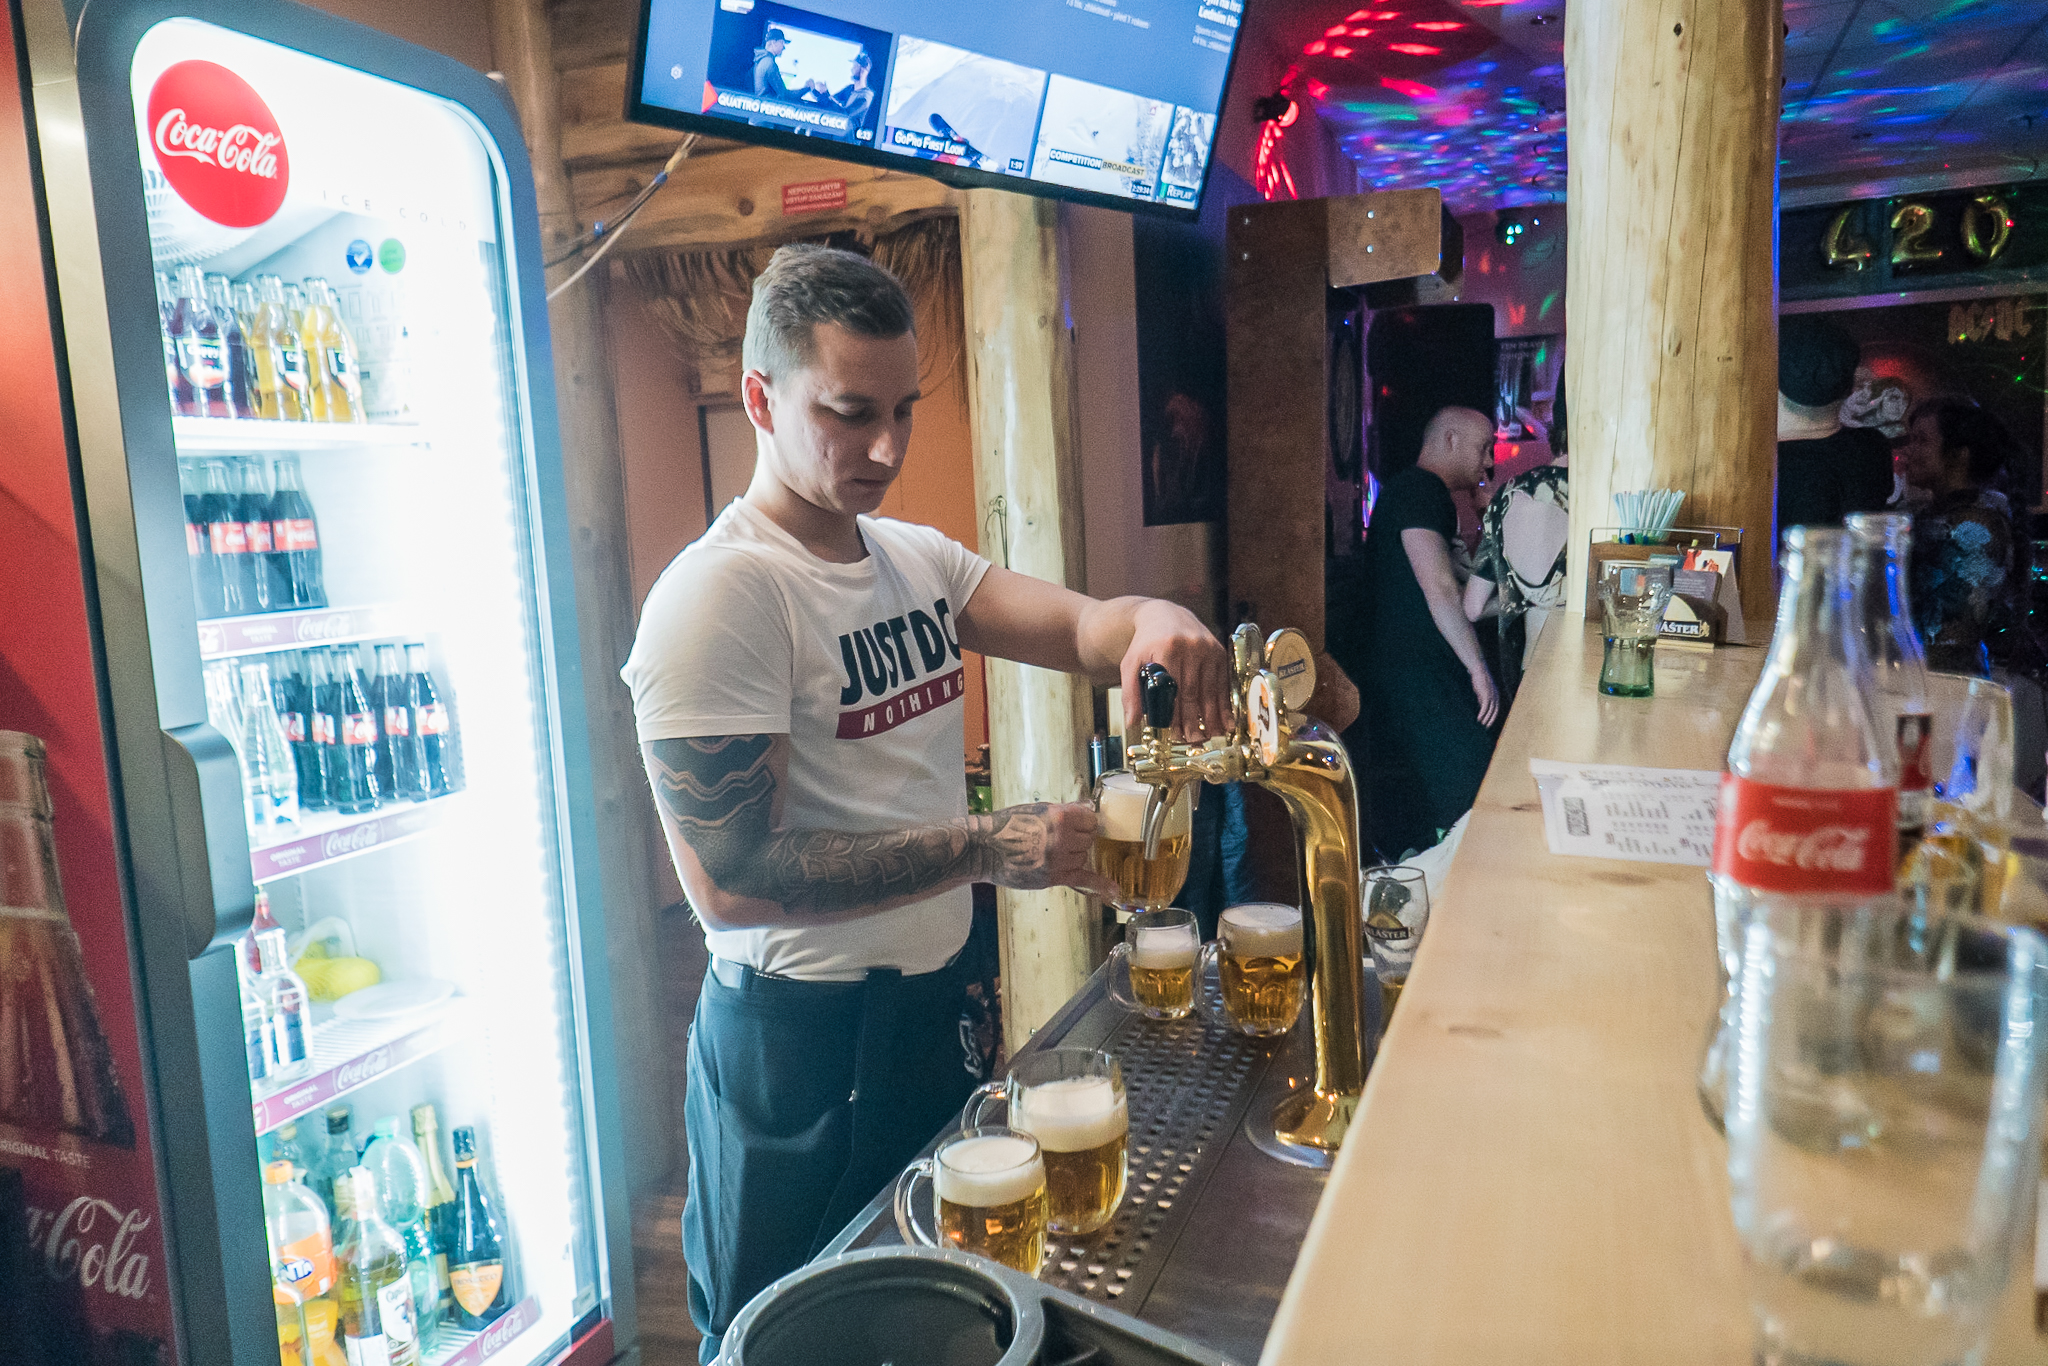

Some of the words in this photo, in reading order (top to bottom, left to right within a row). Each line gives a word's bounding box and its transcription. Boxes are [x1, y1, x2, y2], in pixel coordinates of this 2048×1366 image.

[718, 93, 760, 113] QUATTRO
[760, 102, 821, 125] PERFORMANCE
[820, 113, 848, 130] CHECK
[155, 107, 281, 179] Coca-Cola
[1050, 150, 1101, 168] COMPETITION
[1102, 161, 1145, 176] BROADCAST
[322, 190, 372, 211] ICE
[398, 206, 467, 231] COLD
[1661, 620, 1699, 634] ÁŠTER
[838, 615, 916, 706] JUST
[863, 673, 963, 733] NOTHING
[325, 822, 379, 857] Coca-Cola
[1737, 819, 1870, 872] Coca-Cola
[337, 1050, 388, 1090] Coca-Cola
[0, 1139, 50, 1160] RIGINAL
[52, 1149, 91, 1169] TASTE
[482, 1309, 523, 1357] Coca-Cola
